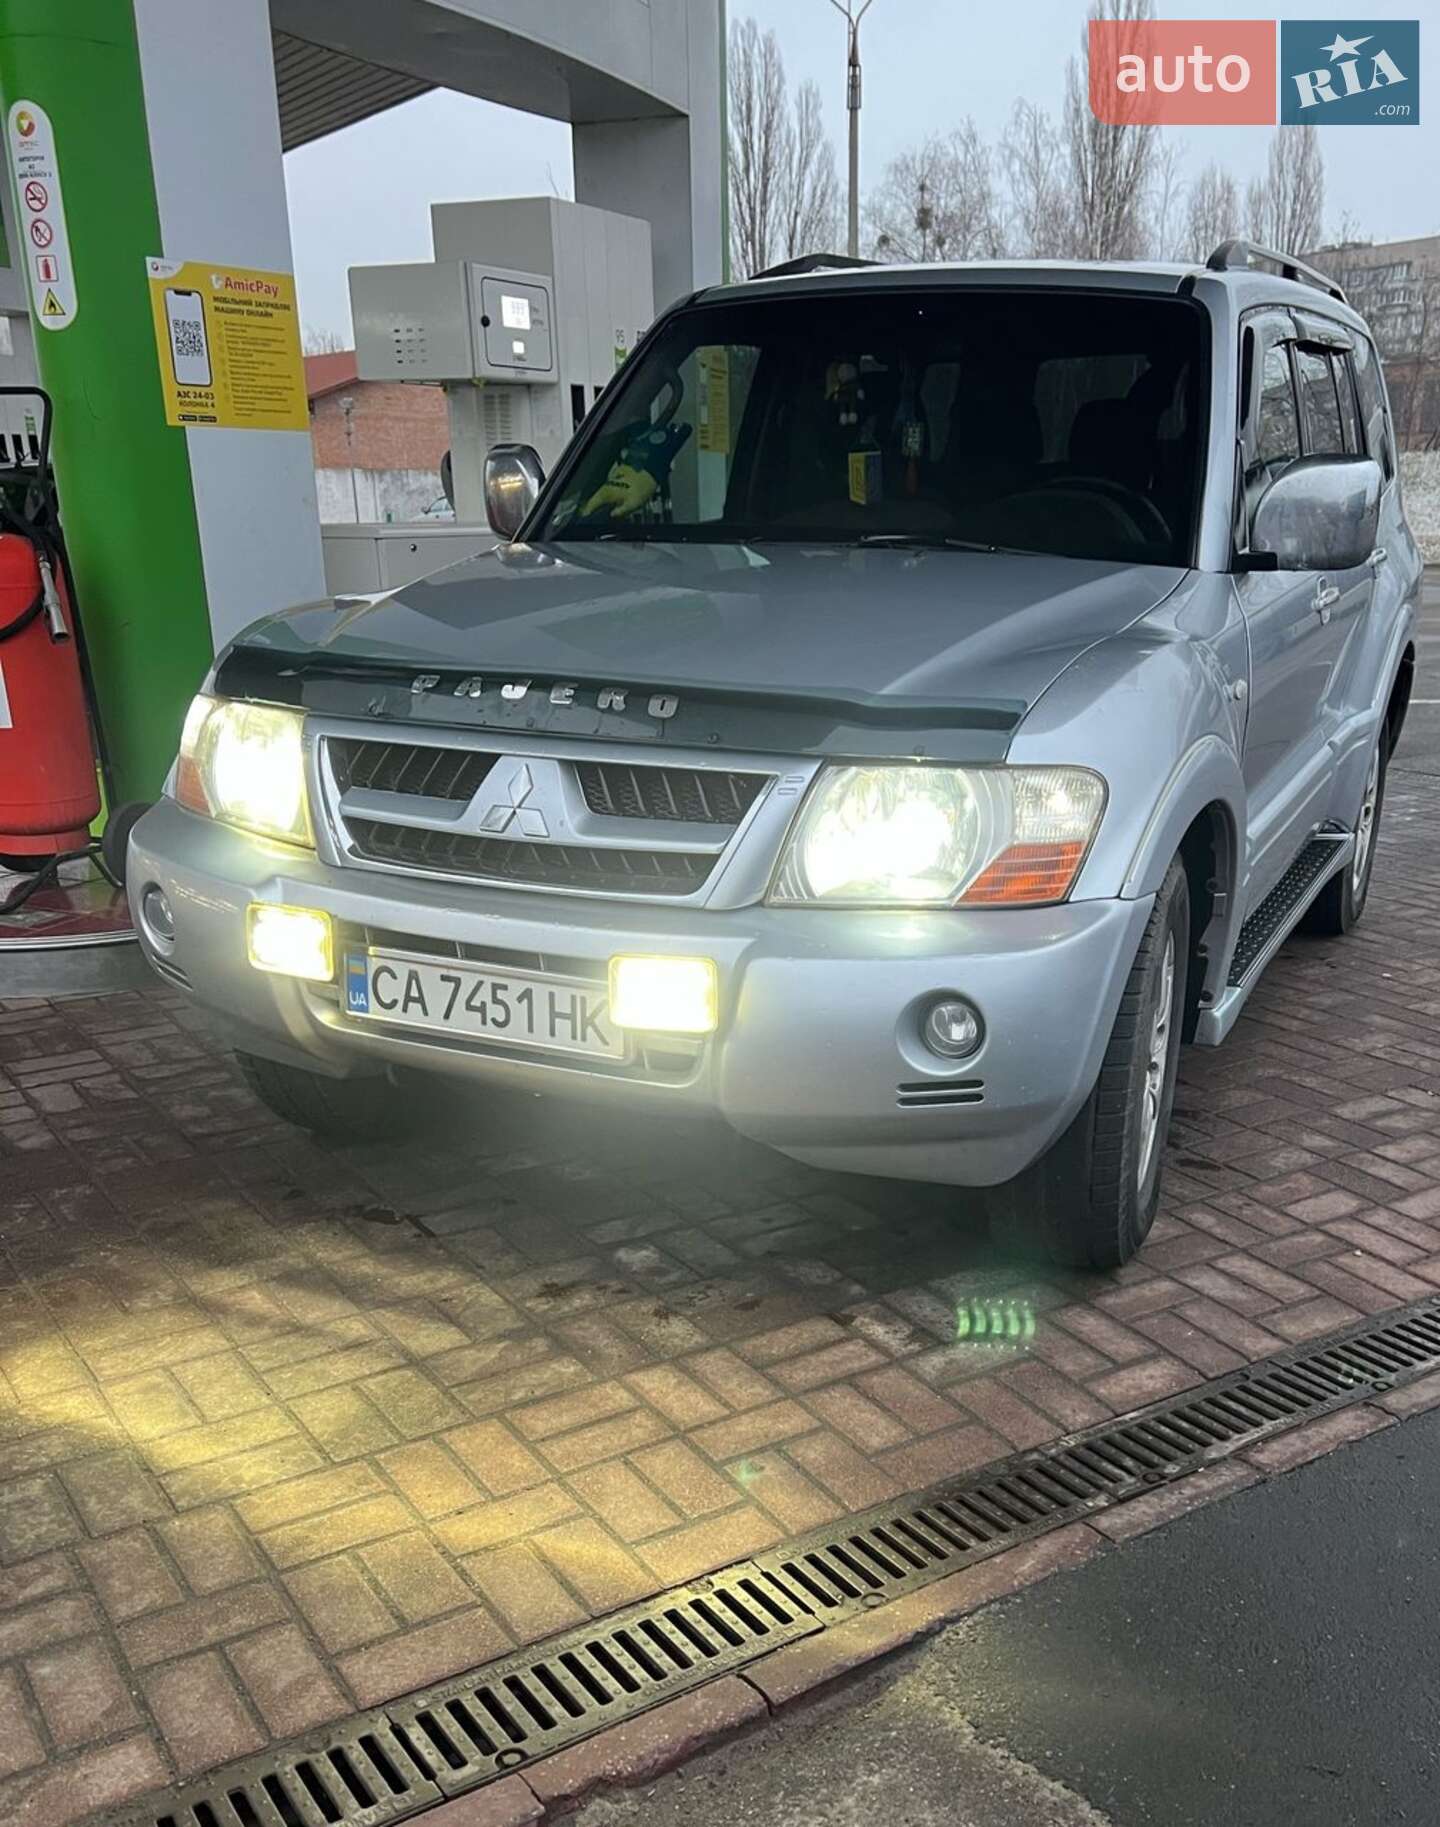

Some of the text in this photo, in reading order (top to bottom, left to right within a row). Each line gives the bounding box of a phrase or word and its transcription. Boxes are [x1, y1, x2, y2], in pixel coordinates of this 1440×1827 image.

[224, 277, 279, 298] AmicPay
[410, 674, 680, 718] PAJERO
[349, 990, 368, 1006] UA
[371, 965, 609, 1046] CA 7451 HK
